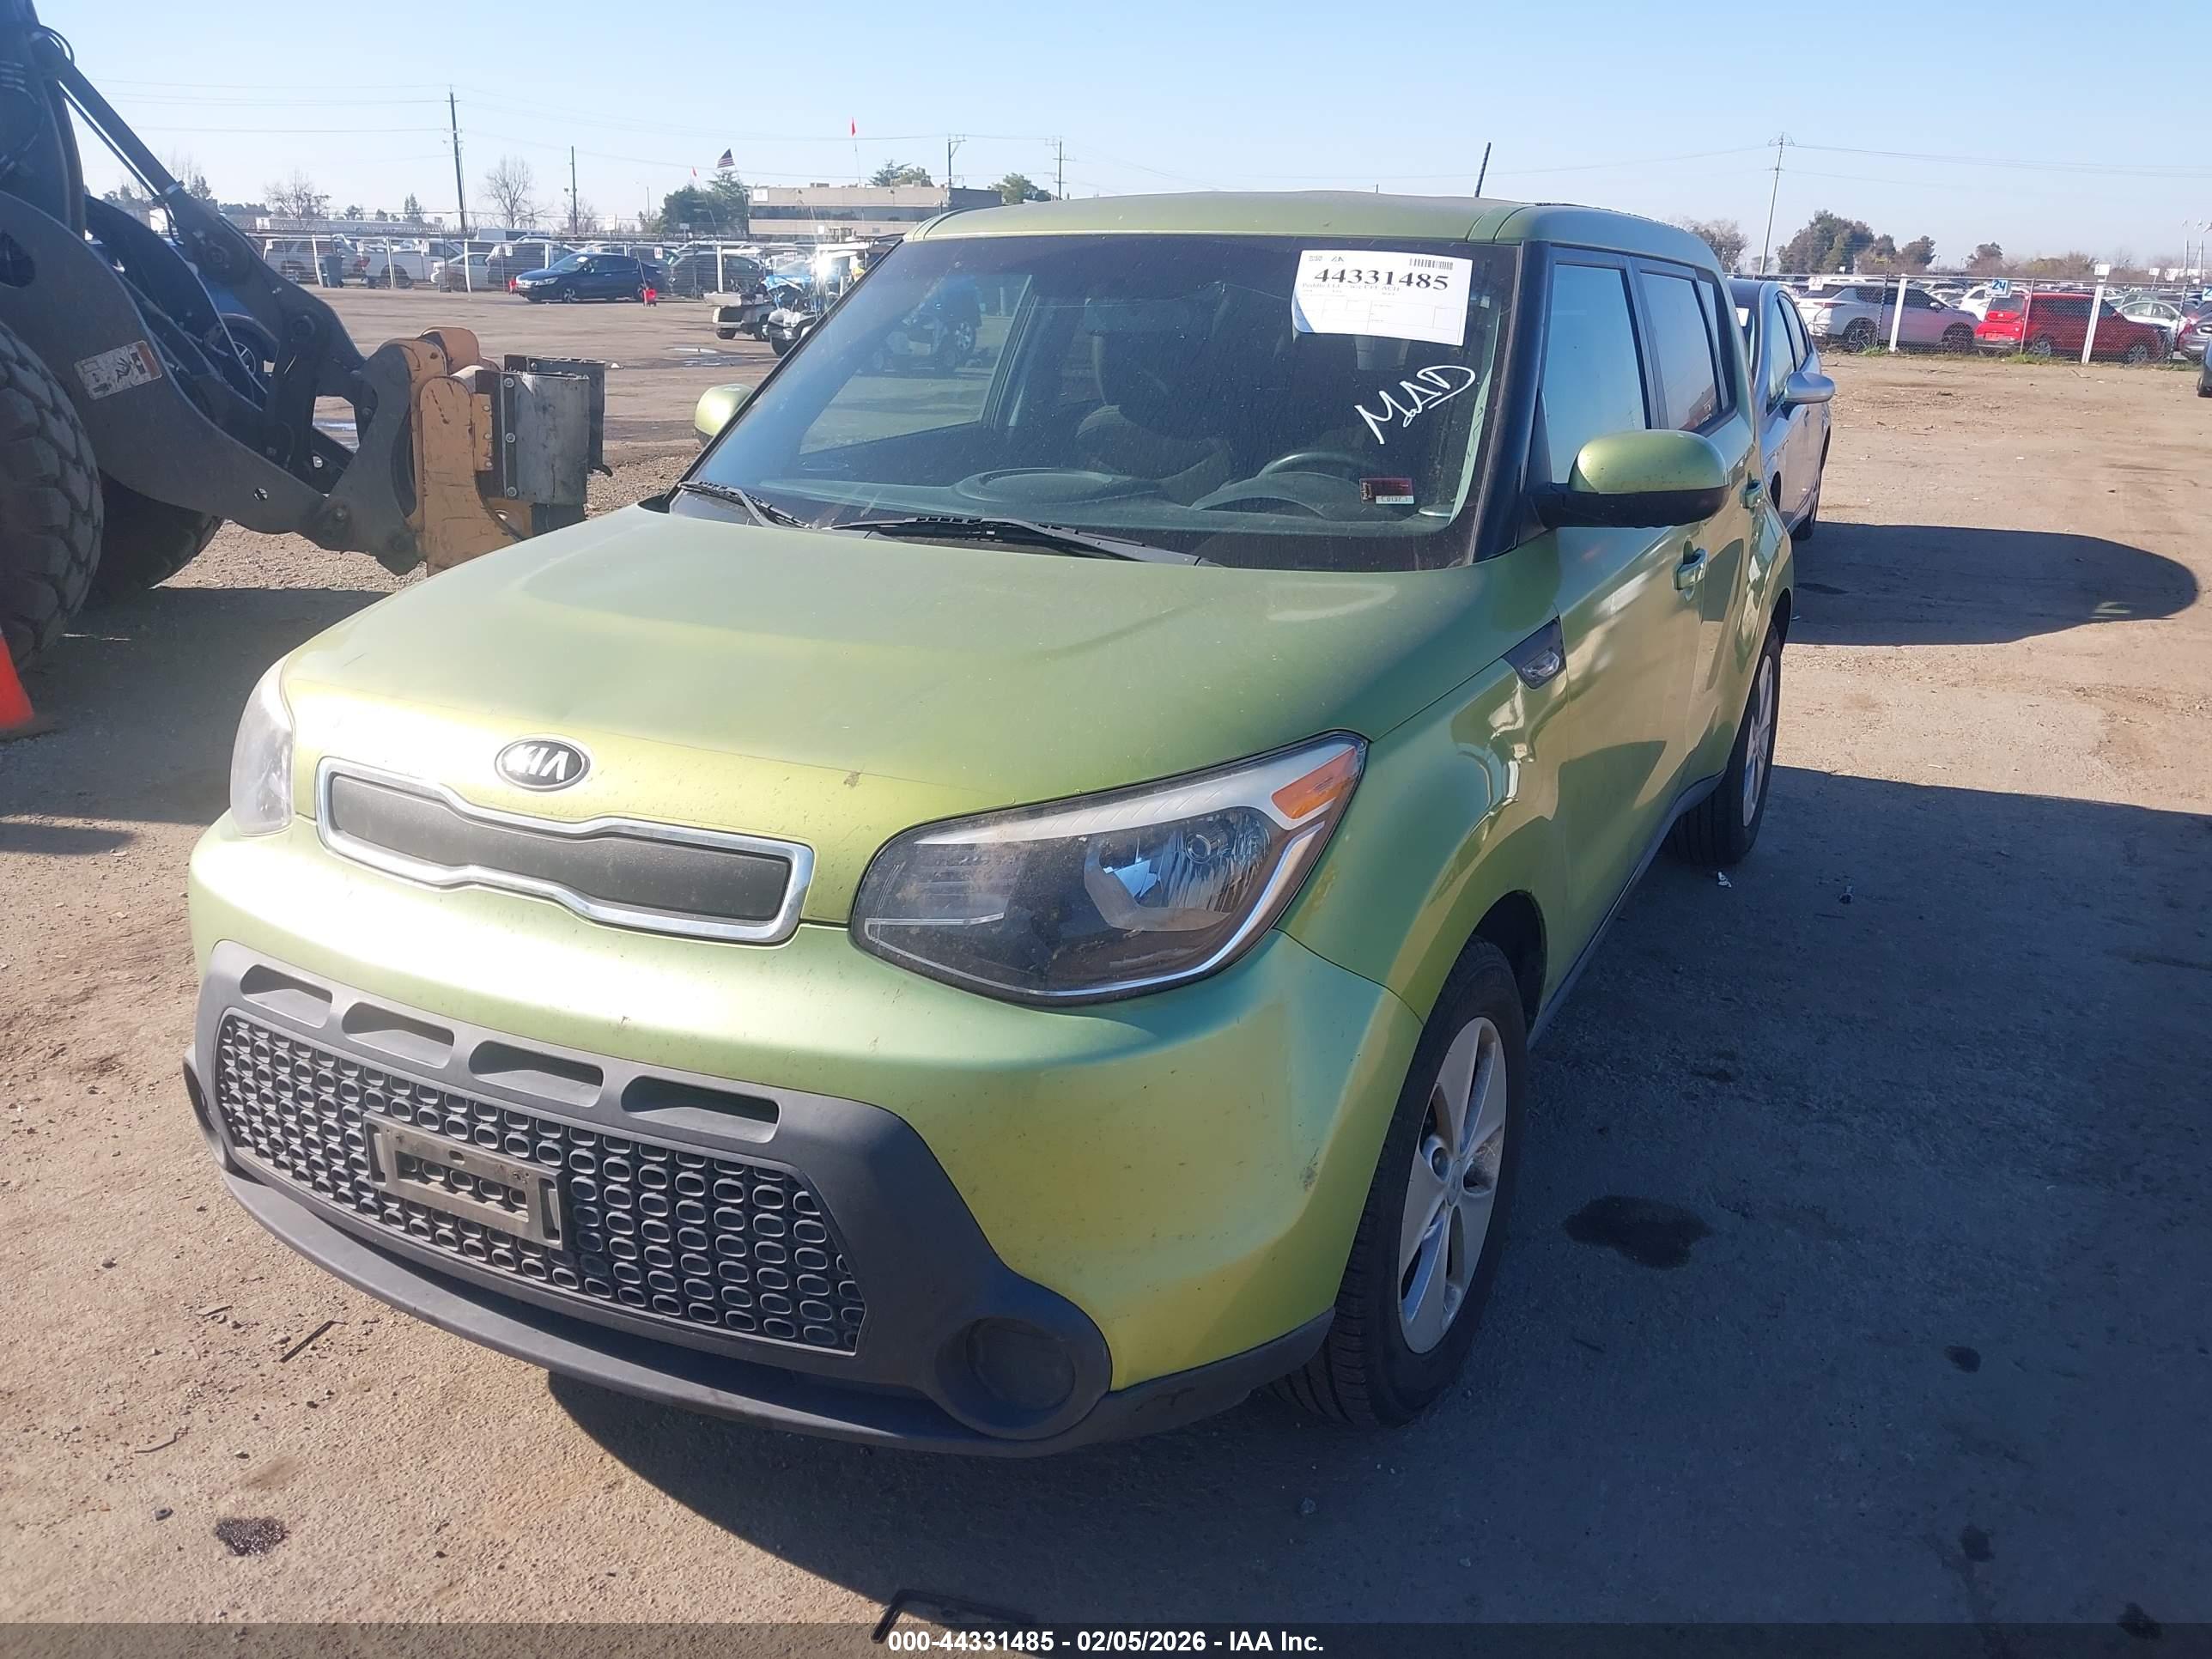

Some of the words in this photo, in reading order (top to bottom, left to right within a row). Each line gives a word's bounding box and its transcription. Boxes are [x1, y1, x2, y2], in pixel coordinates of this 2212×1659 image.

[1315, 267, 1449, 291] 44331485
[1991, 279, 2007, 292] 24
[503, 744, 569, 781] KIA
